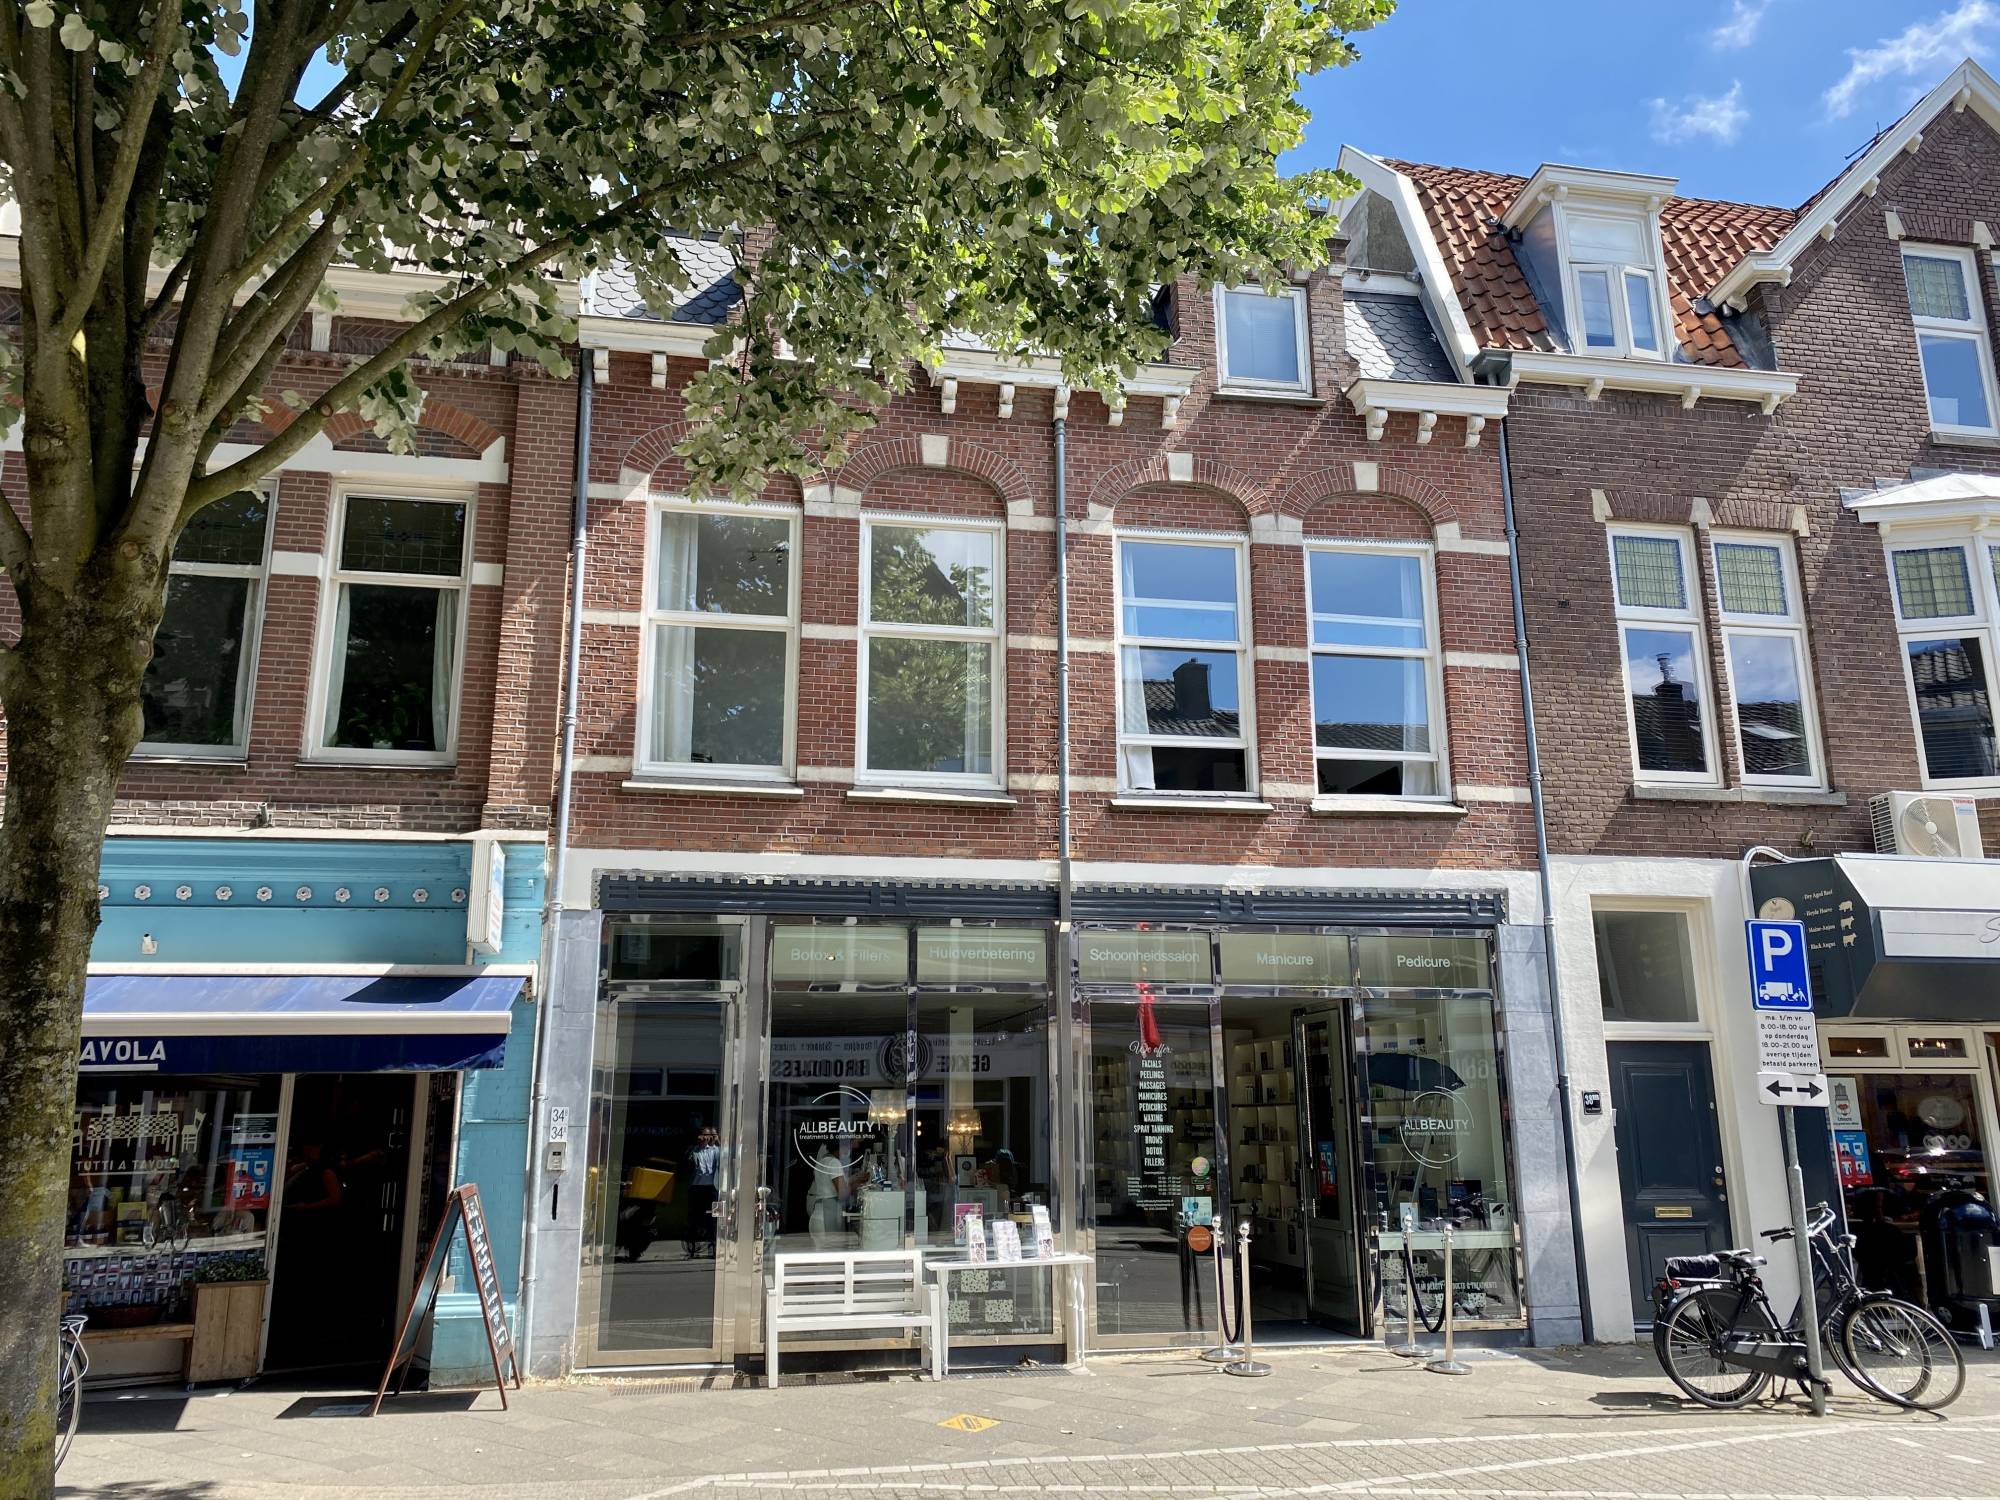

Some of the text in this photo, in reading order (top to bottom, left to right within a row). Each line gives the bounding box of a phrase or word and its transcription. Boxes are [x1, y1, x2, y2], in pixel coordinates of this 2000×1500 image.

[791, 948, 831, 960] Botox
[850, 950, 890, 962] Fillers
[929, 944, 1035, 963] Huidverbetering
[1090, 948, 1200, 962] Schoonheidssalon
[1762, 929, 1792, 972] P
[1257, 953, 1314, 966] Manicure
[1397, 955, 1451, 968] Pedicure
[1141, 1060, 1162, 1068] FACIALS
[1140, 1070, 1164, 1079] PEELINGS
[1139, 1081, 1166, 1090] MASSAGES
[1138, 1092, 1168, 1101] MANICURES
[1139, 1103, 1167, 1112] PEDICURES
[1143, 1114, 1164, 1122] WAXING
[800, 1121, 875, 1133] ALLBEAUTY
[1133, 1124, 1174, 1134] SPRAY TANNING
[1404, 1119, 1469, 1130] ALLBEAUTY
[1144, 1136, 1163, 1145] BROWS
[1145, 1146, 1163, 1155] BOTOX
[75, 1158, 180, 1171] TUTTI A TAVOLA
[1144, 1157, 1165, 1167] FILLERS
